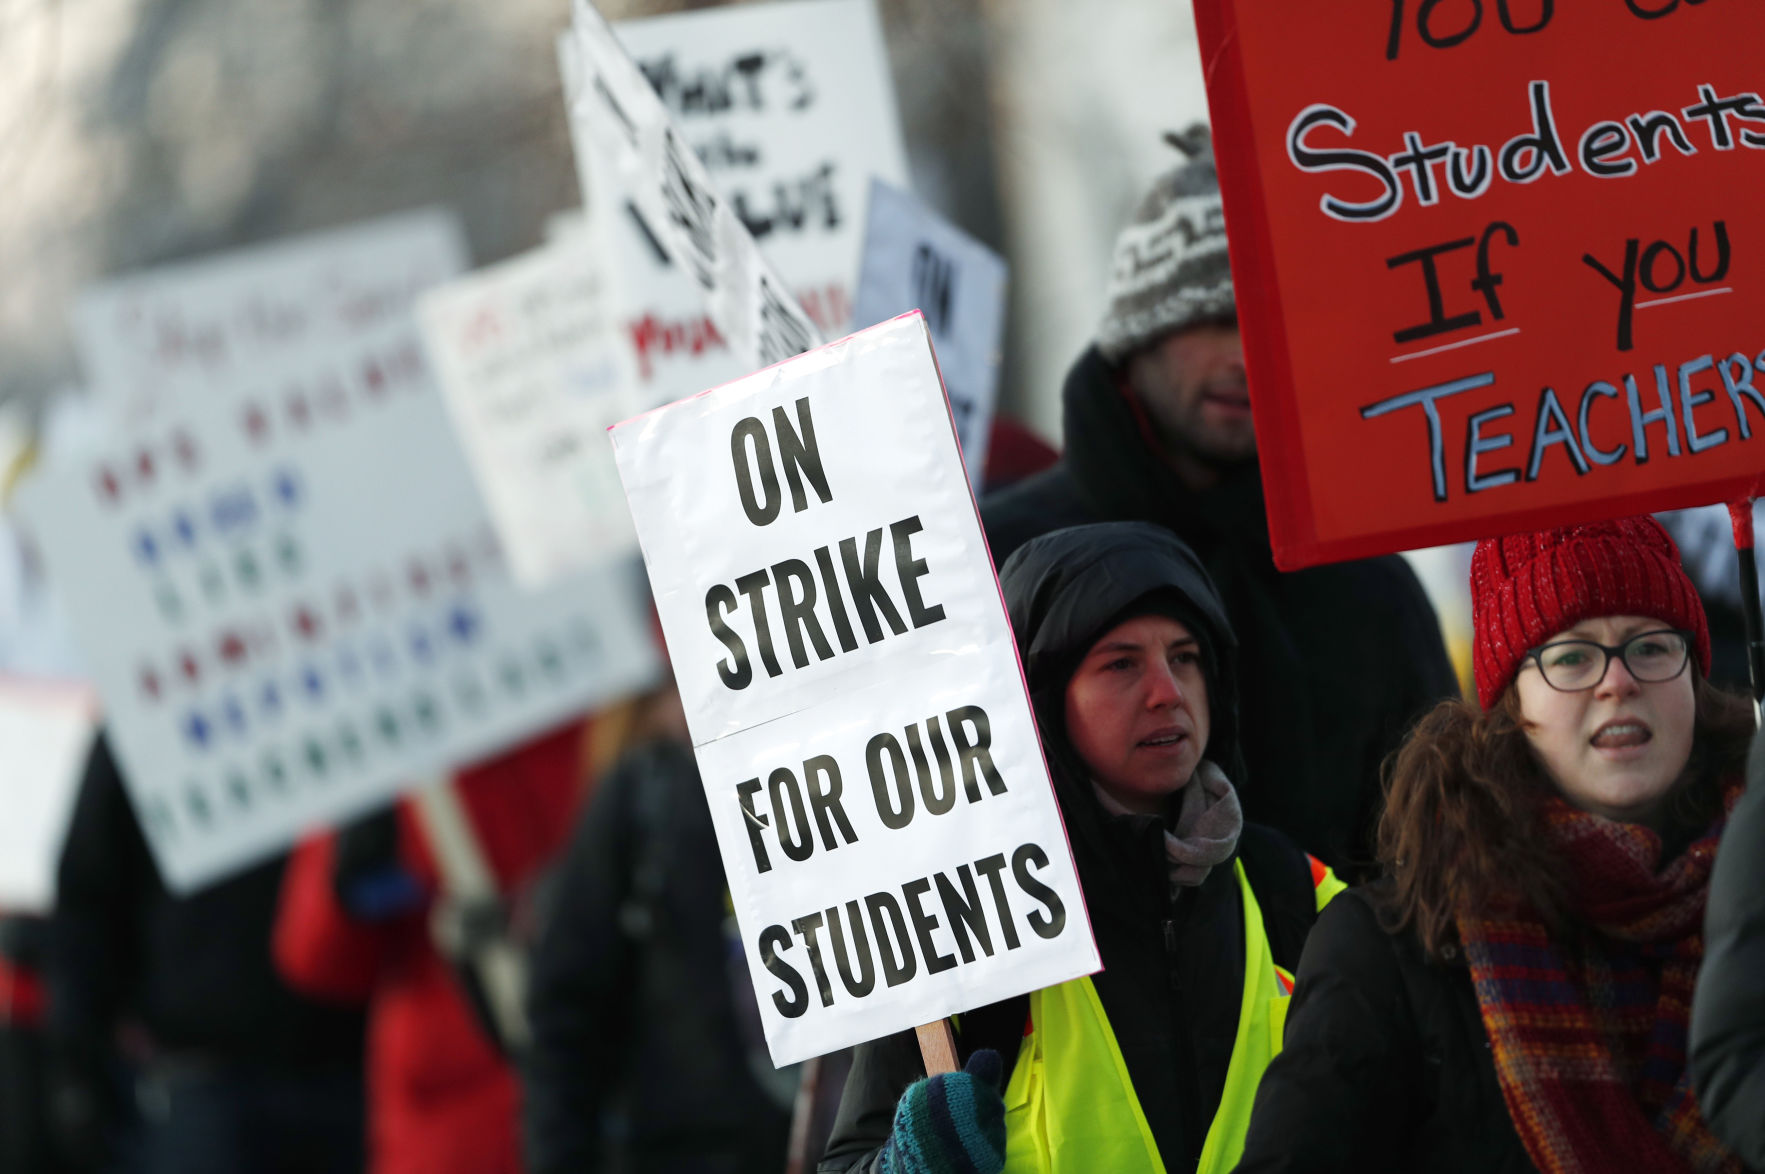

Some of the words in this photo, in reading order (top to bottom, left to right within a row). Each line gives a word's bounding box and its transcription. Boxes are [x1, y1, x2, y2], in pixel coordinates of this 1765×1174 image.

[1386, 221, 1520, 344] If
[731, 396, 833, 527] ON
[705, 514, 947, 691] STRIKE
[735, 754, 859, 875] FOR
[865, 705, 1008, 830] OUR
[758, 842, 1066, 1019] STUDENTS
